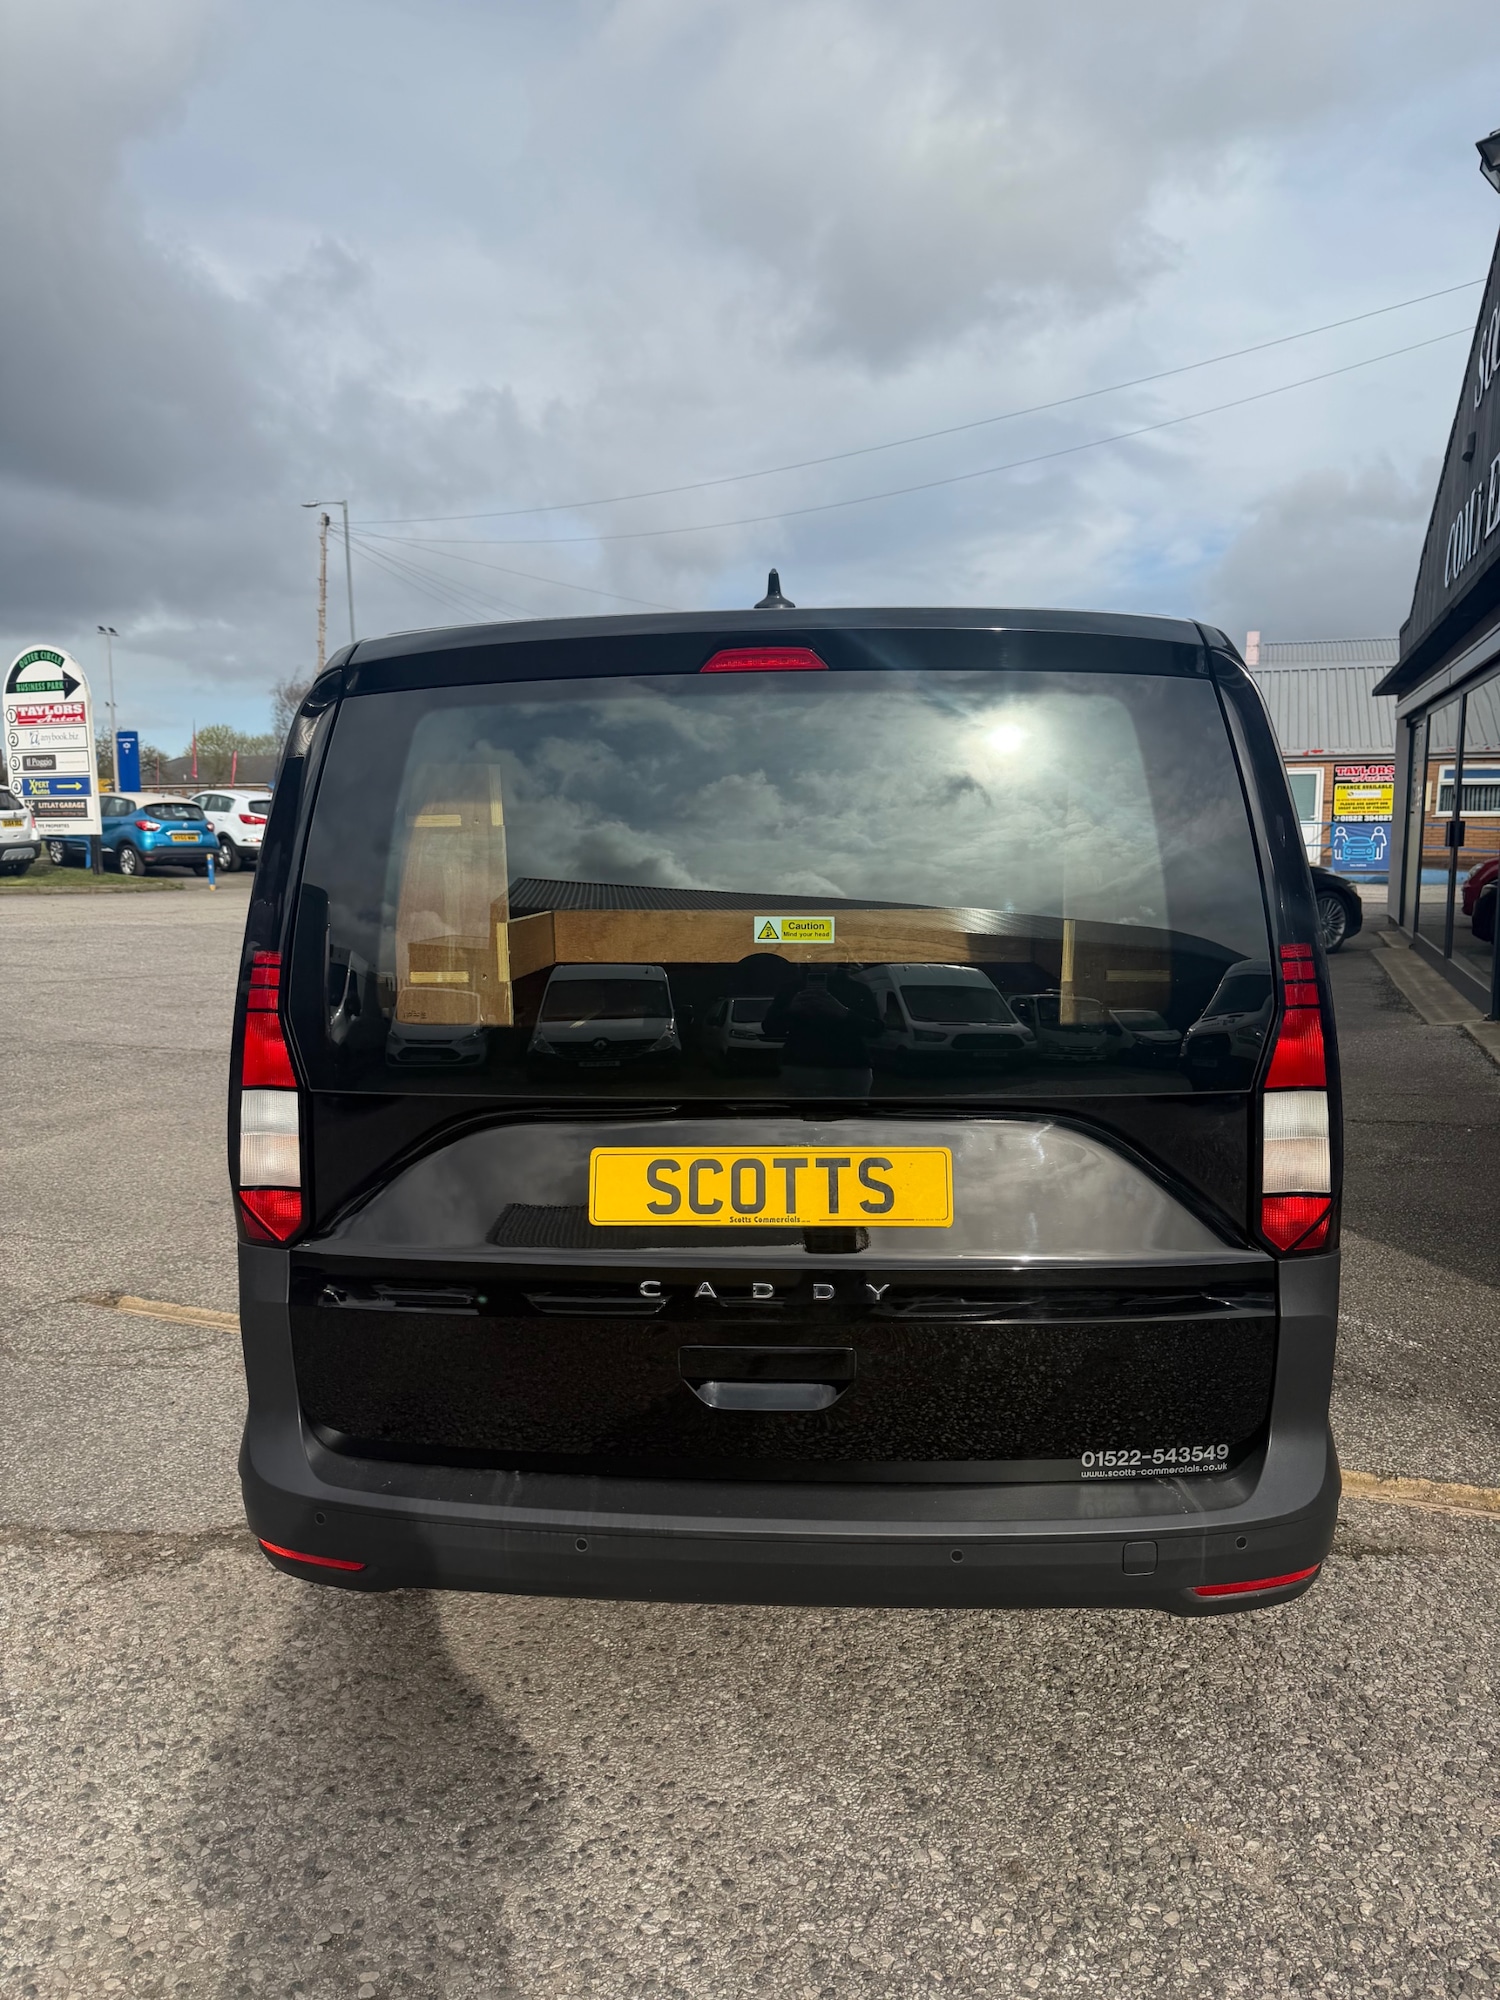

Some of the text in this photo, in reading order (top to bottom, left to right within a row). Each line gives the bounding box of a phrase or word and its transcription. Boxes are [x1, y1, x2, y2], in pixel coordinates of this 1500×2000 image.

[19, 651, 62, 668] OUTER CIRCLE
[16, 681, 64, 692] BUSINESS PARK
[18, 704, 83, 716] TAYLORS
[36, 715, 82, 723] Autos
[1335, 765, 1395, 776] TAYLORS
[788, 922, 825, 930] Caution
[646, 1157, 895, 1215] SCOTTS
[754, 1215, 800, 1223] Commercials
[639, 1281, 890, 1301] CADDY
[1081, 1444, 1229, 1468] 01522-543549
[1081, 1462, 1228, 1478] www.scotts-commercials.co.uk
